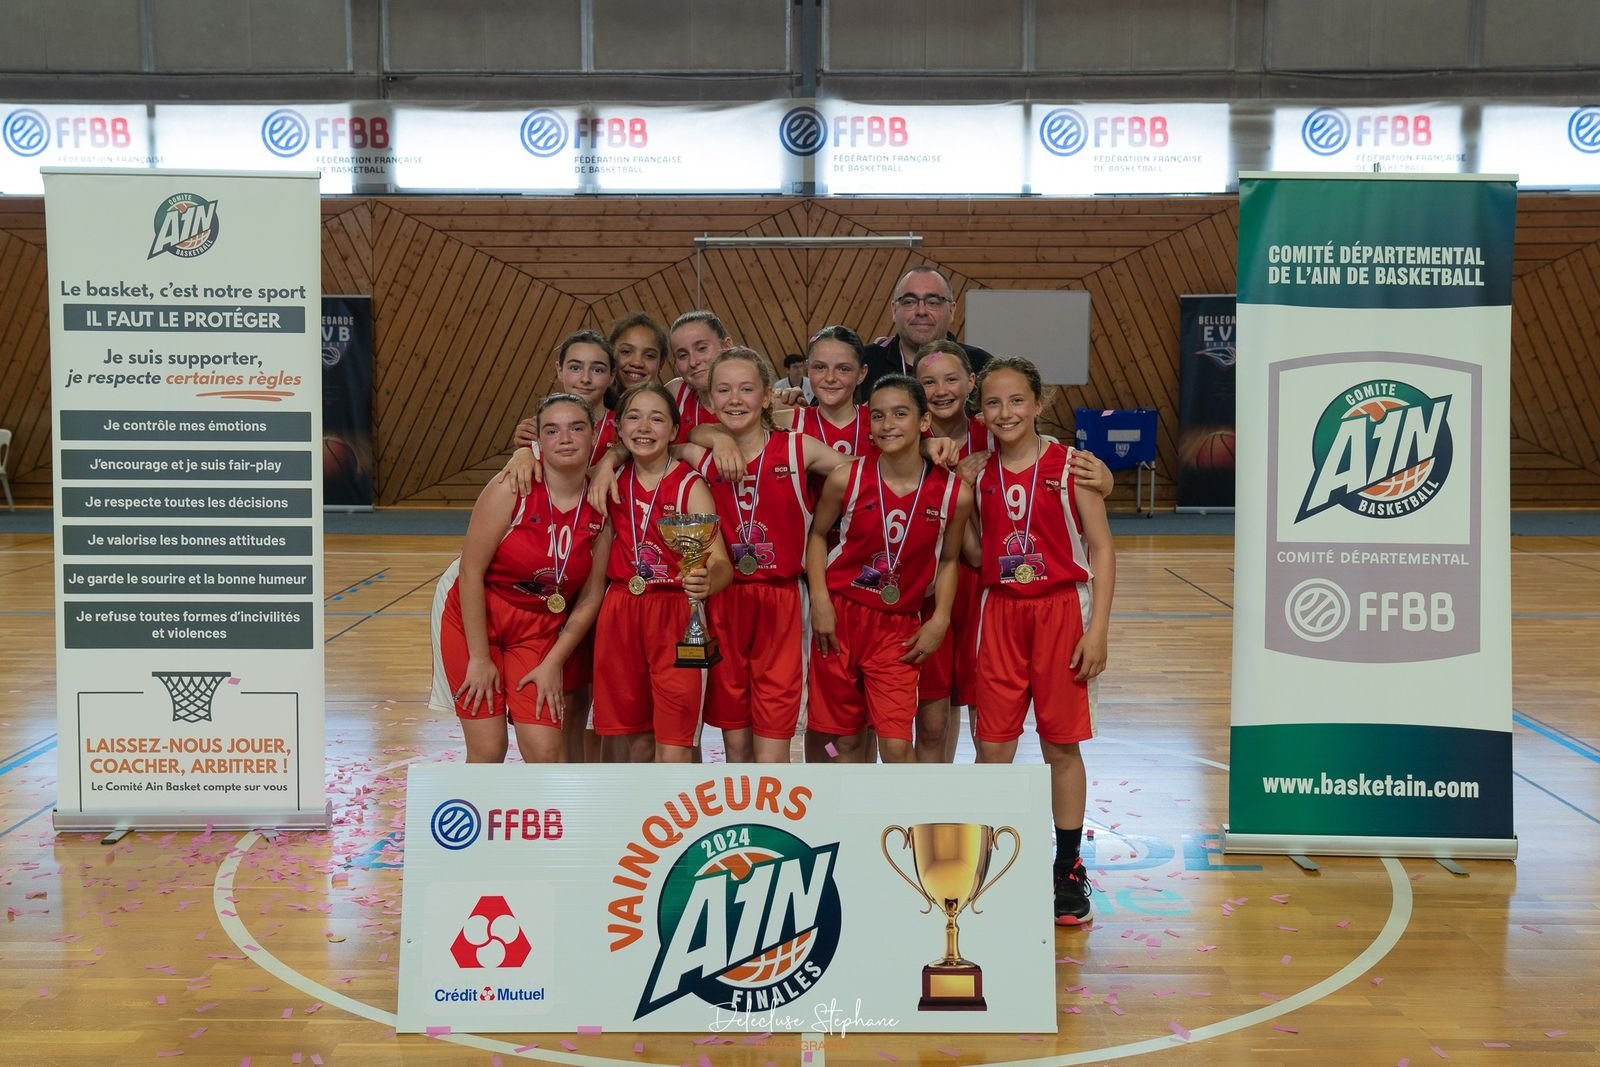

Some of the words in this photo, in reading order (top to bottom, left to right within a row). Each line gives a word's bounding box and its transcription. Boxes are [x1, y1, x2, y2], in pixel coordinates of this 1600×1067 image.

[57, 117, 131, 148] FFBB
[315, 116, 390, 149] FFBB
[573, 117, 648, 149] FFBB
[833, 116, 909, 148] FFBB
[1094, 116, 1169, 148] FFBB
[1356, 115, 1432, 147] FFBB
[316, 155, 371, 164] FÉDÉRATION
[574, 155, 630, 163] FÉDÉRATION
[833, 154, 890, 163] FÉDÉRATION
[833, 164, 845, 172] DE
[848, 164, 904, 172] BASKETBALL
[1094, 154, 1150, 163] FÉDÉRATION
[1094, 164, 1105, 172] DE
[1108, 164, 1163, 172] BASKETBALL
[316, 166, 328, 174] DE
[331, 166, 386, 174] BASKETBALL
[574, 166, 586, 174] DE
[589, 166, 643, 174] BASKETBALL
[175, 239, 213, 257] BASKETBALL
[1268, 240, 1334, 264] COMITÉ
[1339, 241, 1485, 266] DÉPARTEMENTAL
[1268, 266, 1292, 285] DE
[1346, 267, 1369, 286] DE
[1374, 267, 1485, 287] BASKETBALL
[61, 280, 81, 298] Le
[86, 281, 155, 300] basket,
[203, 285, 253, 299] notre
[258, 286, 306, 303] sport
[86, 310, 103, 327] IL
[107, 310, 154, 328] FAUT
[159, 311, 179, 328] LE
[184, 307, 281, 329] PROTÉGER
[322, 316, 354, 325] EGARDE
[1199, 315, 1236, 325] BELLEGA
[103, 348, 124, 365] Je
[128, 349, 163, 366] suis
[167, 351, 263, 369] supporter,
[65, 369, 83, 388] je
[87, 372, 161, 388] respecte
[165, 371, 244, 386] certaines
[248, 370, 302, 389] règles
[1345, 383, 1397, 406] COMITE
[103, 419, 121, 431] Je
[123, 419, 176, 432] contrôle
[179, 422, 205, 432] mes
[208, 420, 267, 432] émotions
[171, 460, 184, 471] et
[186, 460, 198, 473] je
[201, 460, 226, 471] suis
[228, 459, 282, 474] fair-play
[738, 474, 759, 511] 5
[1006, 484, 1027, 521] 9
[1358, 479, 1440, 516] BASKETBALL
[85, 496, 102, 508] Je
[105, 497, 162, 510] respecte
[164, 497, 205, 508] toutes
[208, 497, 226, 508] les
[228, 496, 289, 509] décisions
[883, 508, 907, 544] 6
[87, 534, 104, 546] Je
[107, 534, 157, 546] valorise
[160, 534, 178, 546] les
[180, 534, 227, 546] bonnes
[229, 534, 286, 546] attitudes
[547, 524, 572, 560] 10
[1276, 549, 1335, 564] COMITÉ
[1340, 550, 1470, 566] DÉPARTEMENTAL
[68, 573, 85, 584] Je
[87, 573, 124, 587] garde
[127, 573, 139, 584] le
[141, 573, 186, 585] sourire
[188, 574, 202, 585] et
[204, 573, 215, 585] la
[217, 573, 256, 585] bonne
[258, 574, 307, 585] humeur
[76, 611, 93, 622] Je
[95, 611, 137, 622] refuse
[139, 612, 180, 622] toutes
[183, 611, 228, 623] formes
[1359, 591, 1456, 632] FFBB
[152, 628, 165, 639] et
[167, 628, 227, 639] violences
[86, 737, 223, 754] LAISSEZ-NOUS
[226, 737, 292, 756] JOUER,
[90, 757, 186, 777] COACHER,
[190, 758, 278, 775] ARBITRER
[283, 758, 288, 774] !
[91, 781, 103, 792] Le
[105, 781, 143, 792] Comité
[145, 781, 163, 792] Ain
[166, 781, 201, 792] Basket
[203, 782, 242, 793] compte
[244, 783, 260, 792] sur
[263, 783, 288, 792] vous
[1262, 772, 1480, 799] www.basketain.com
[487, 808, 564, 841] FFBB
[700, 827, 751, 859] 2024
[607, 775, 813, 952] VAINQUEURS
[434, 987, 478, 1002] Crédit
[497, 987, 545, 1002] Mutuel
[730, 960, 823, 1010] FINALES
